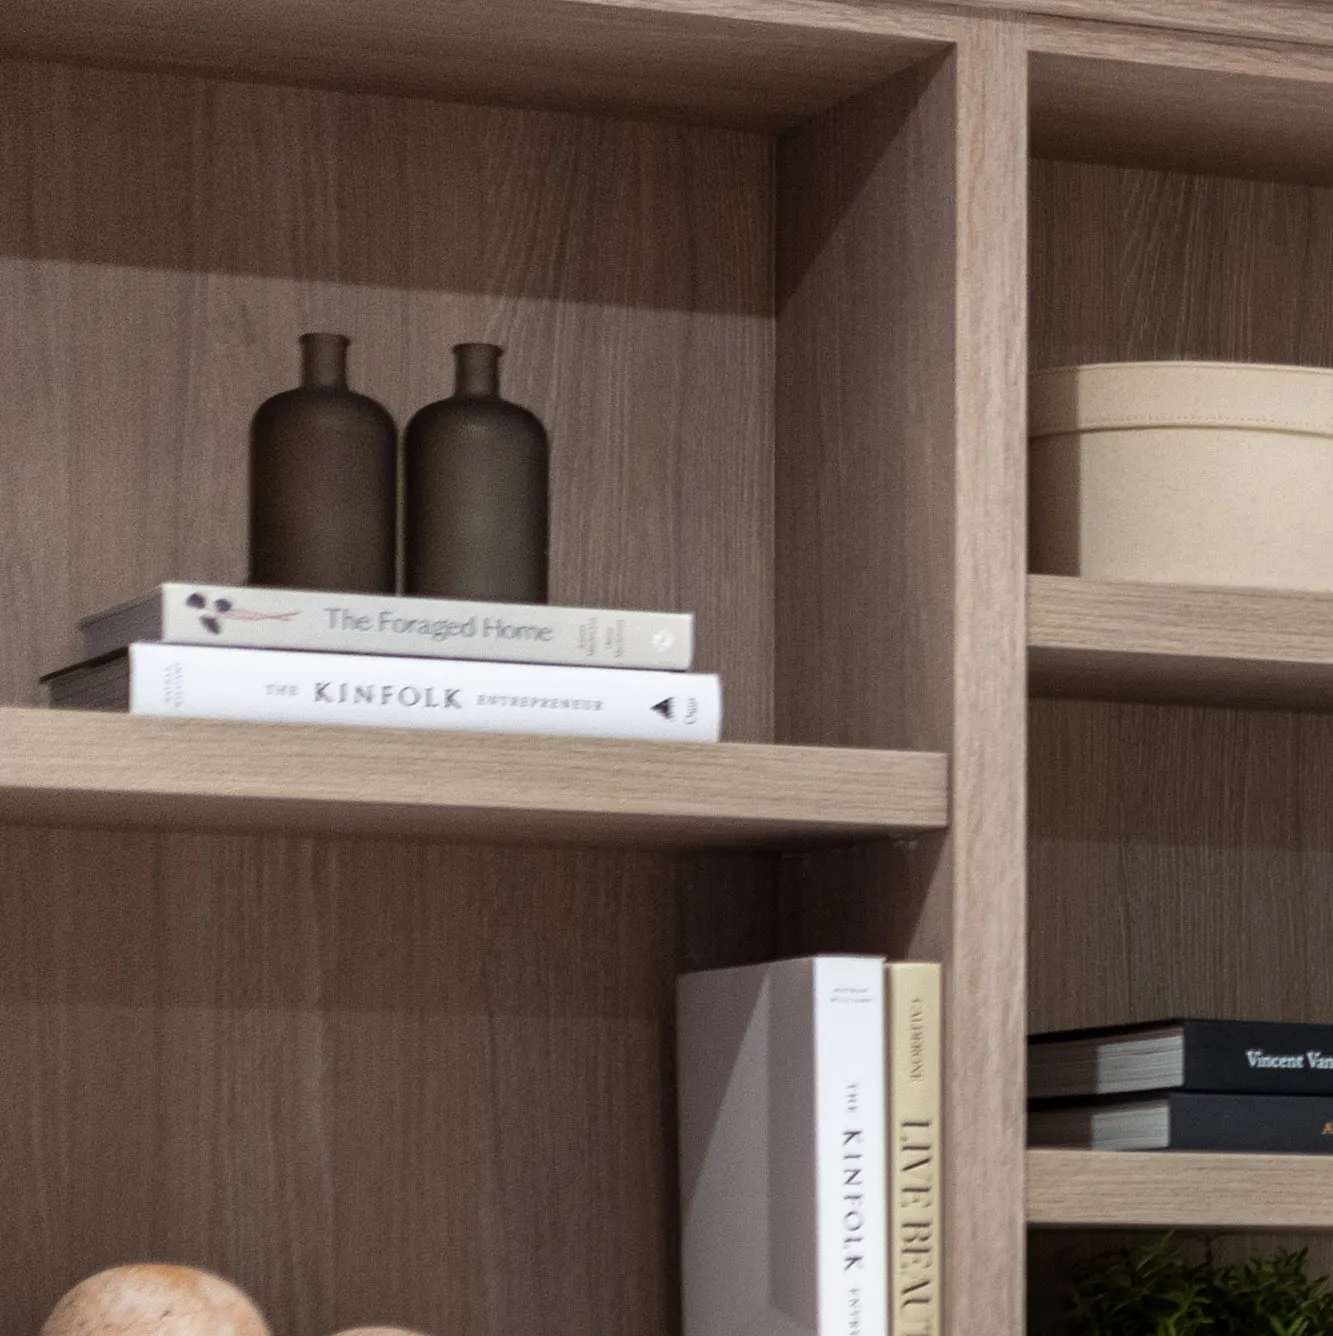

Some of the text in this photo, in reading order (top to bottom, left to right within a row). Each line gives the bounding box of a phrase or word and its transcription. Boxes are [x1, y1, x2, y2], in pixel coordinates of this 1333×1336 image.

[324, 608, 374, 632] The
[378, 610, 477, 642] Foraged
[482, 617, 554, 642] Home
[264, 681, 605, 712] THE KINFOLK ENTREPRENEUR
[1246, 1050, 1305, 1070] Vincent
[900, 1119, 933, 1208] LIVE
[841, 1129, 865, 1273] KINFOLK
